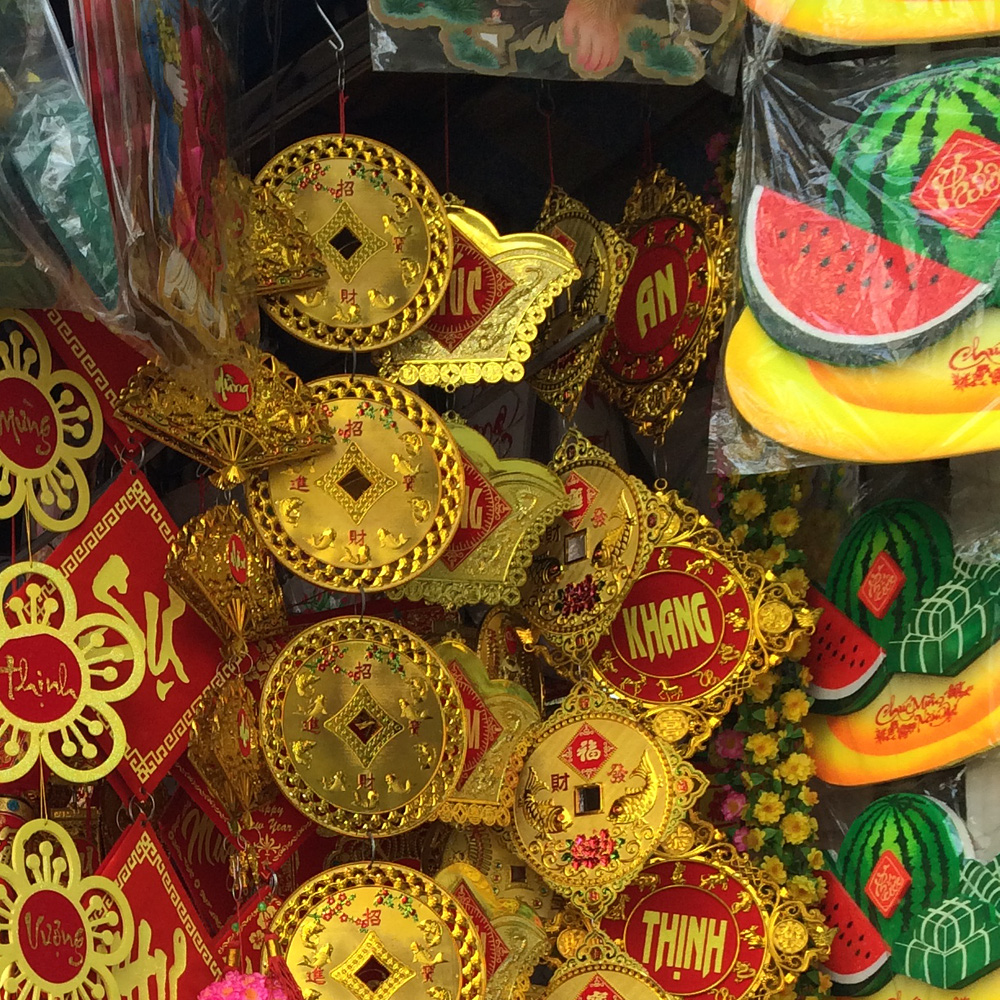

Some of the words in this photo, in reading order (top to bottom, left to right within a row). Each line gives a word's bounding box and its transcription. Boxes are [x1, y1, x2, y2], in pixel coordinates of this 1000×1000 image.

[340, 289, 357, 305] 財
[636, 263, 678, 339] AN
[348, 530, 367, 547] 財
[622, 591, 715, 663] KHANG
[576, 740, 602, 763] 福
[357, 774, 375, 792] 財
[551, 773, 570, 793] 財
[363, 908, 382, 928] 招
[642, 910, 728, 980] THỊNH
